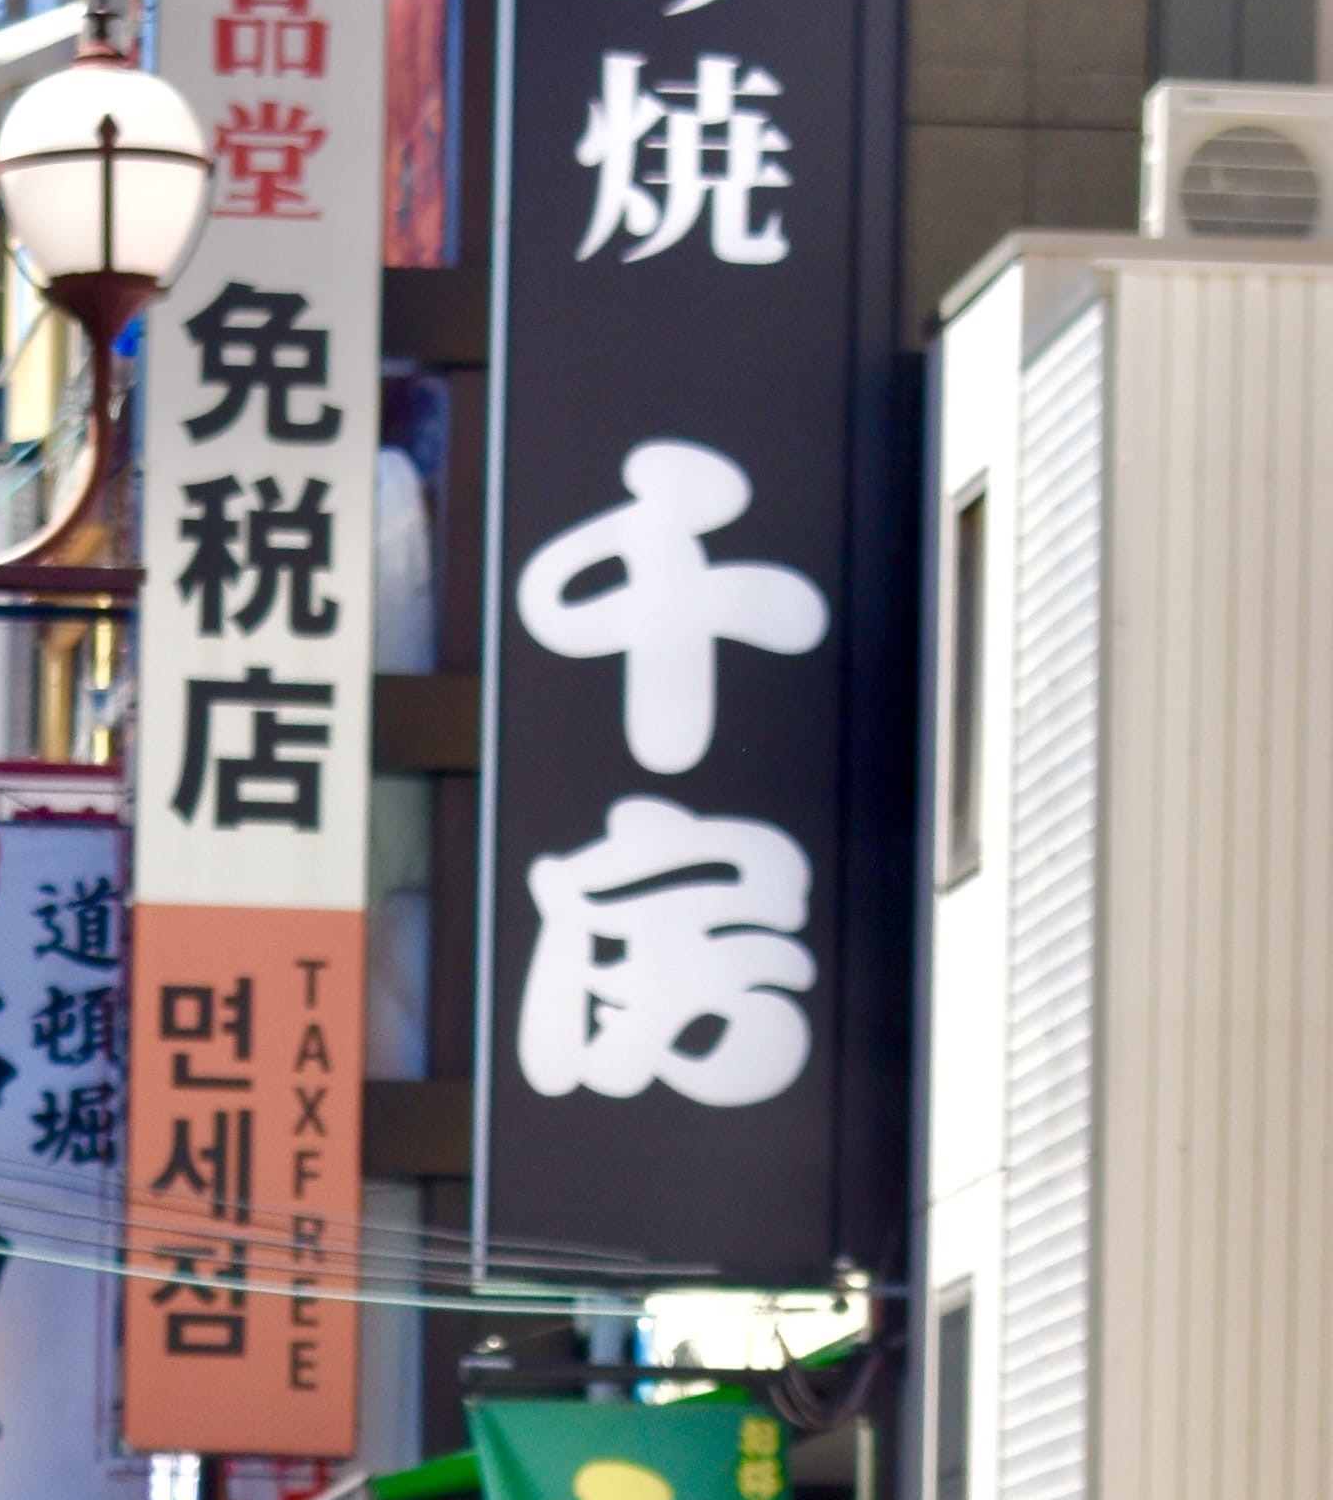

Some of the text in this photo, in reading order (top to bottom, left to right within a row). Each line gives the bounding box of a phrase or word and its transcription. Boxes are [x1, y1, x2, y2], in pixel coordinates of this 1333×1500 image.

[168, 281, 345, 835] 免税店
[516, 437, 832, 1107] 千房
[30, 879, 122, 1167] 道頓堀
[149, 976, 256, 1358] 면세점
